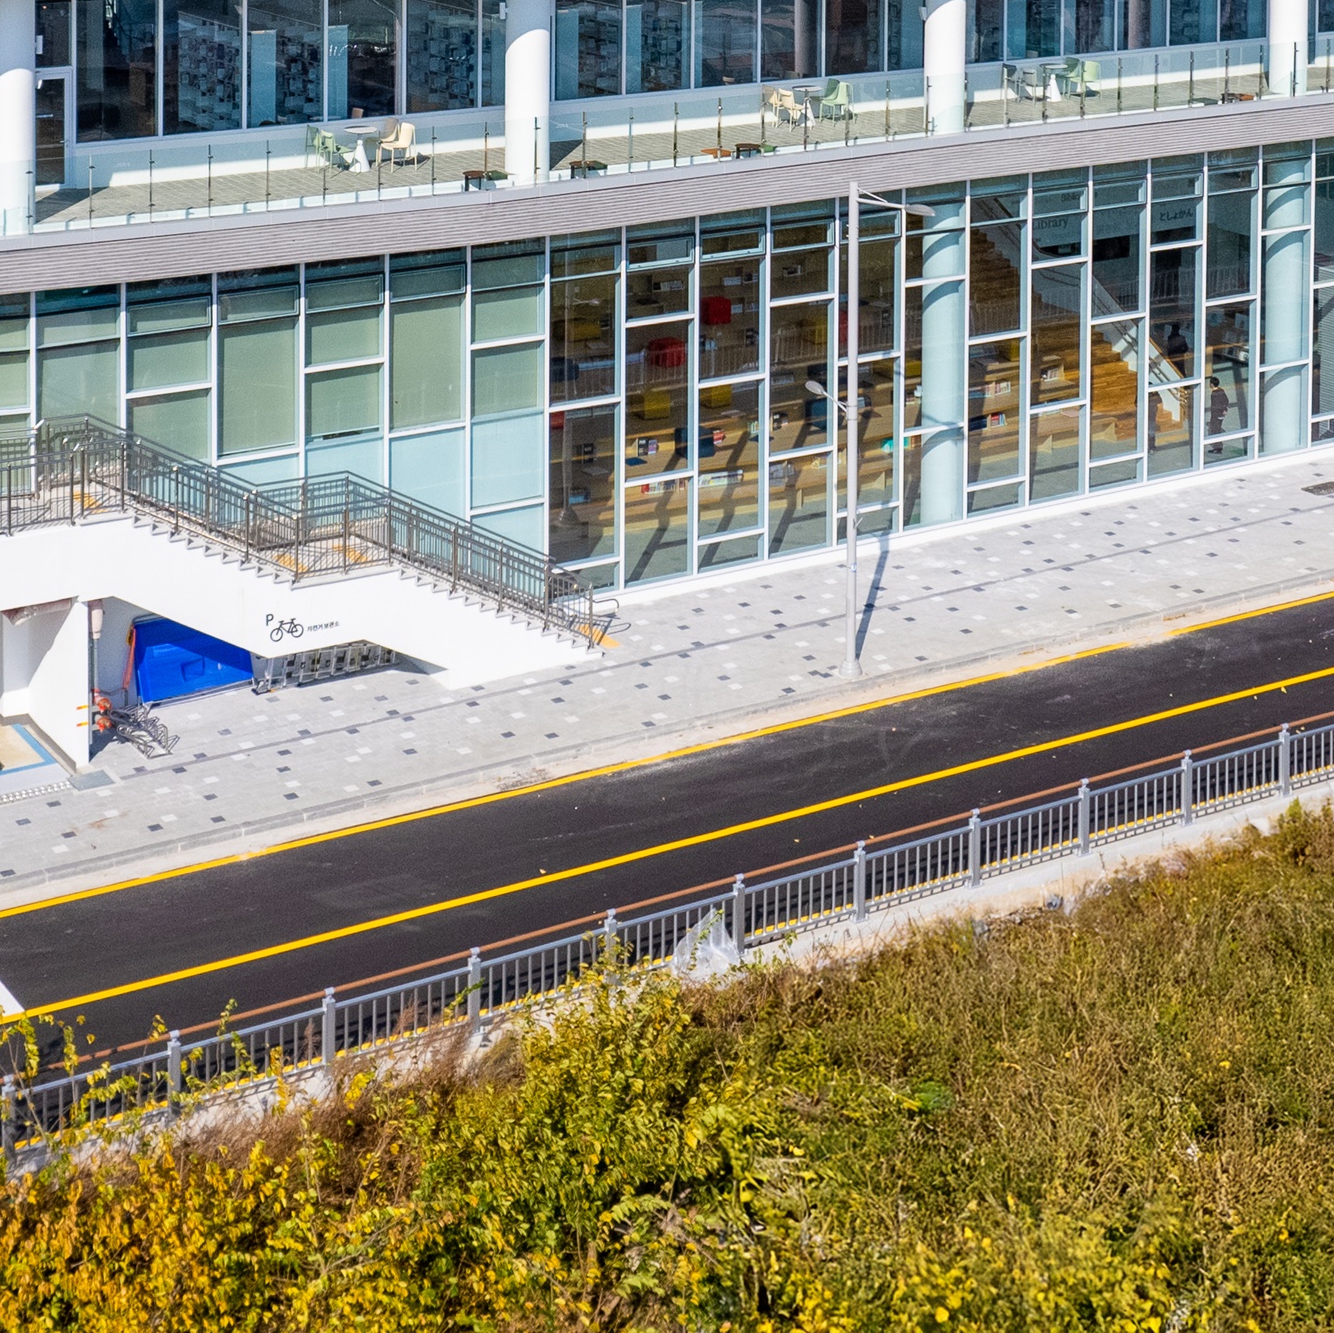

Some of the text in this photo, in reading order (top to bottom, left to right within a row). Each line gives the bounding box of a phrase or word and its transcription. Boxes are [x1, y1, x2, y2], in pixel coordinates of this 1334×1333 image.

[1159, 208, 1194, 222] としょかん
[265, 613, 274, 626] P
